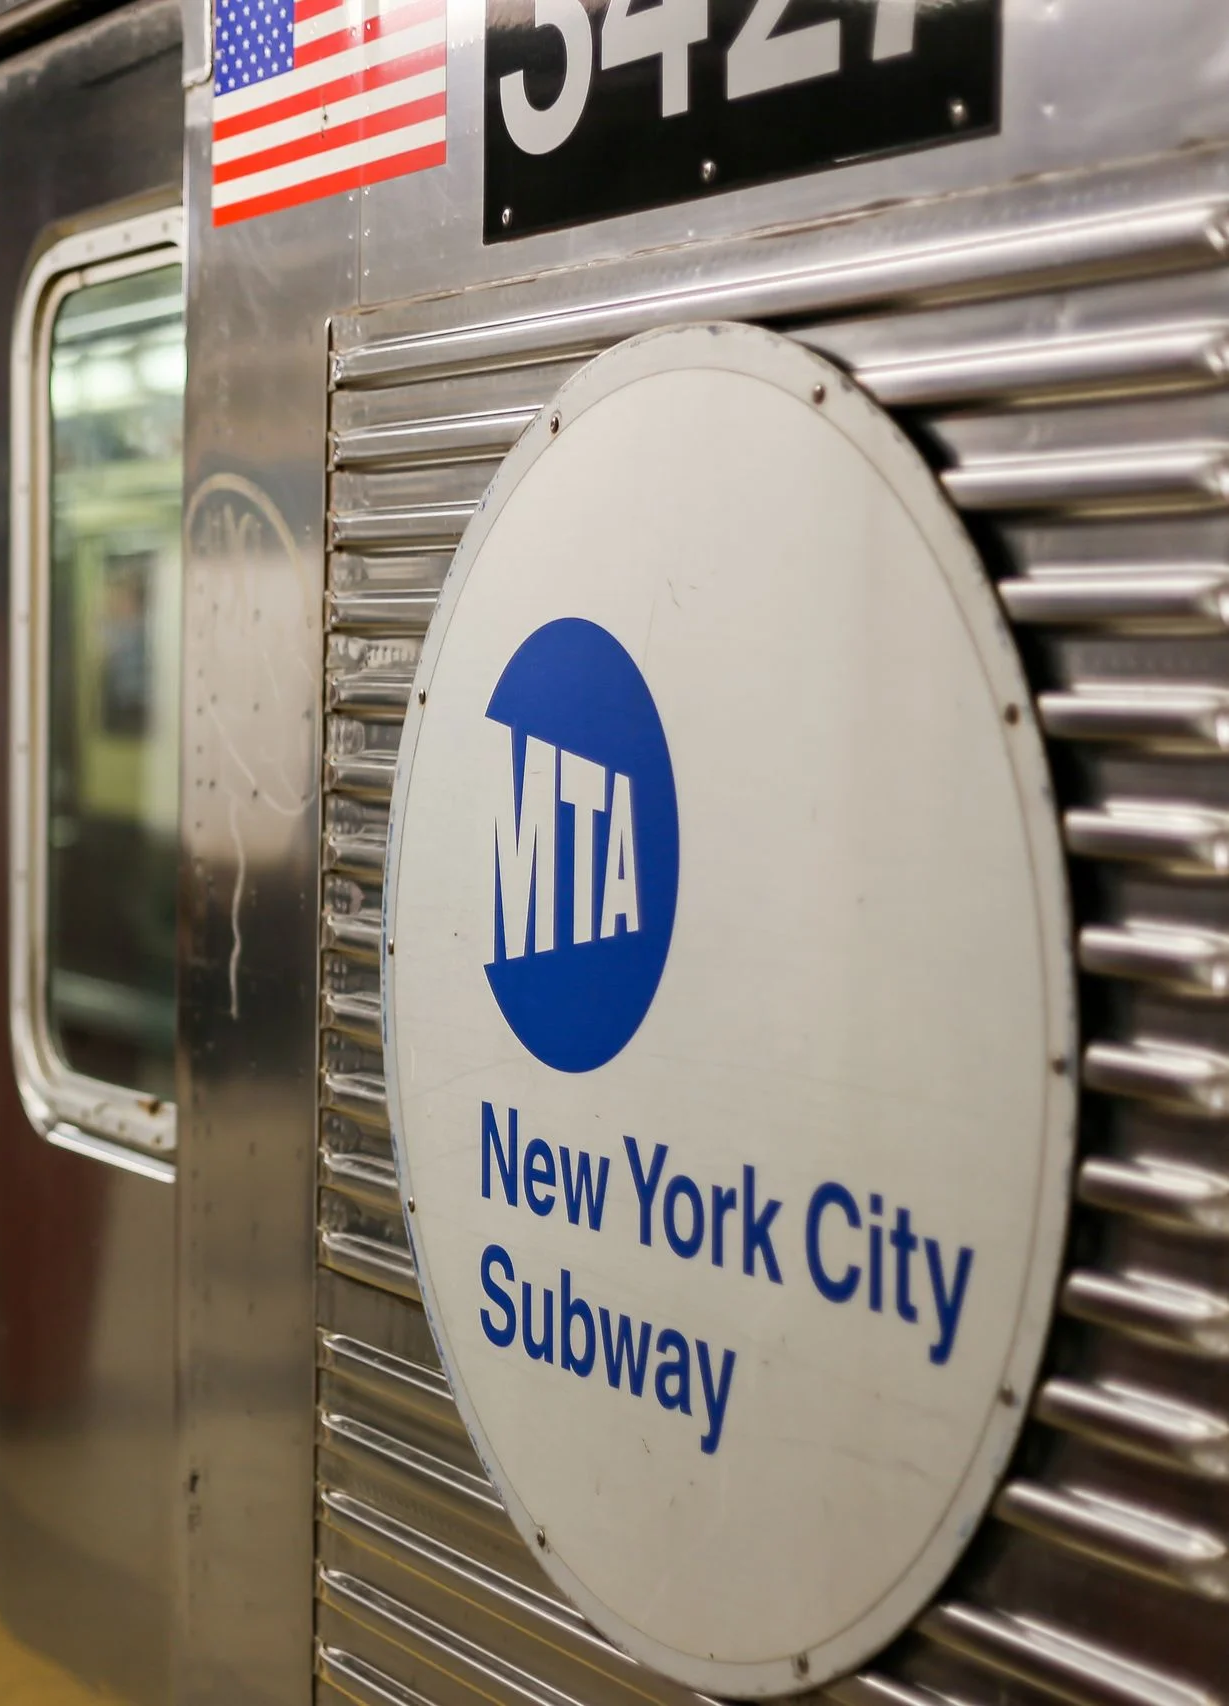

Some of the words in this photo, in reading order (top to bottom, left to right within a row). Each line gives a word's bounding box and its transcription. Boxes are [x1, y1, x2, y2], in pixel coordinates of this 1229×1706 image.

[483, 716, 640, 966] MTA
[479, 1244, 736, 1454] Subway
[481, 1101, 610, 1231] New
[623, 1136, 784, 1284] York
[806, 1182, 973, 1365] City
